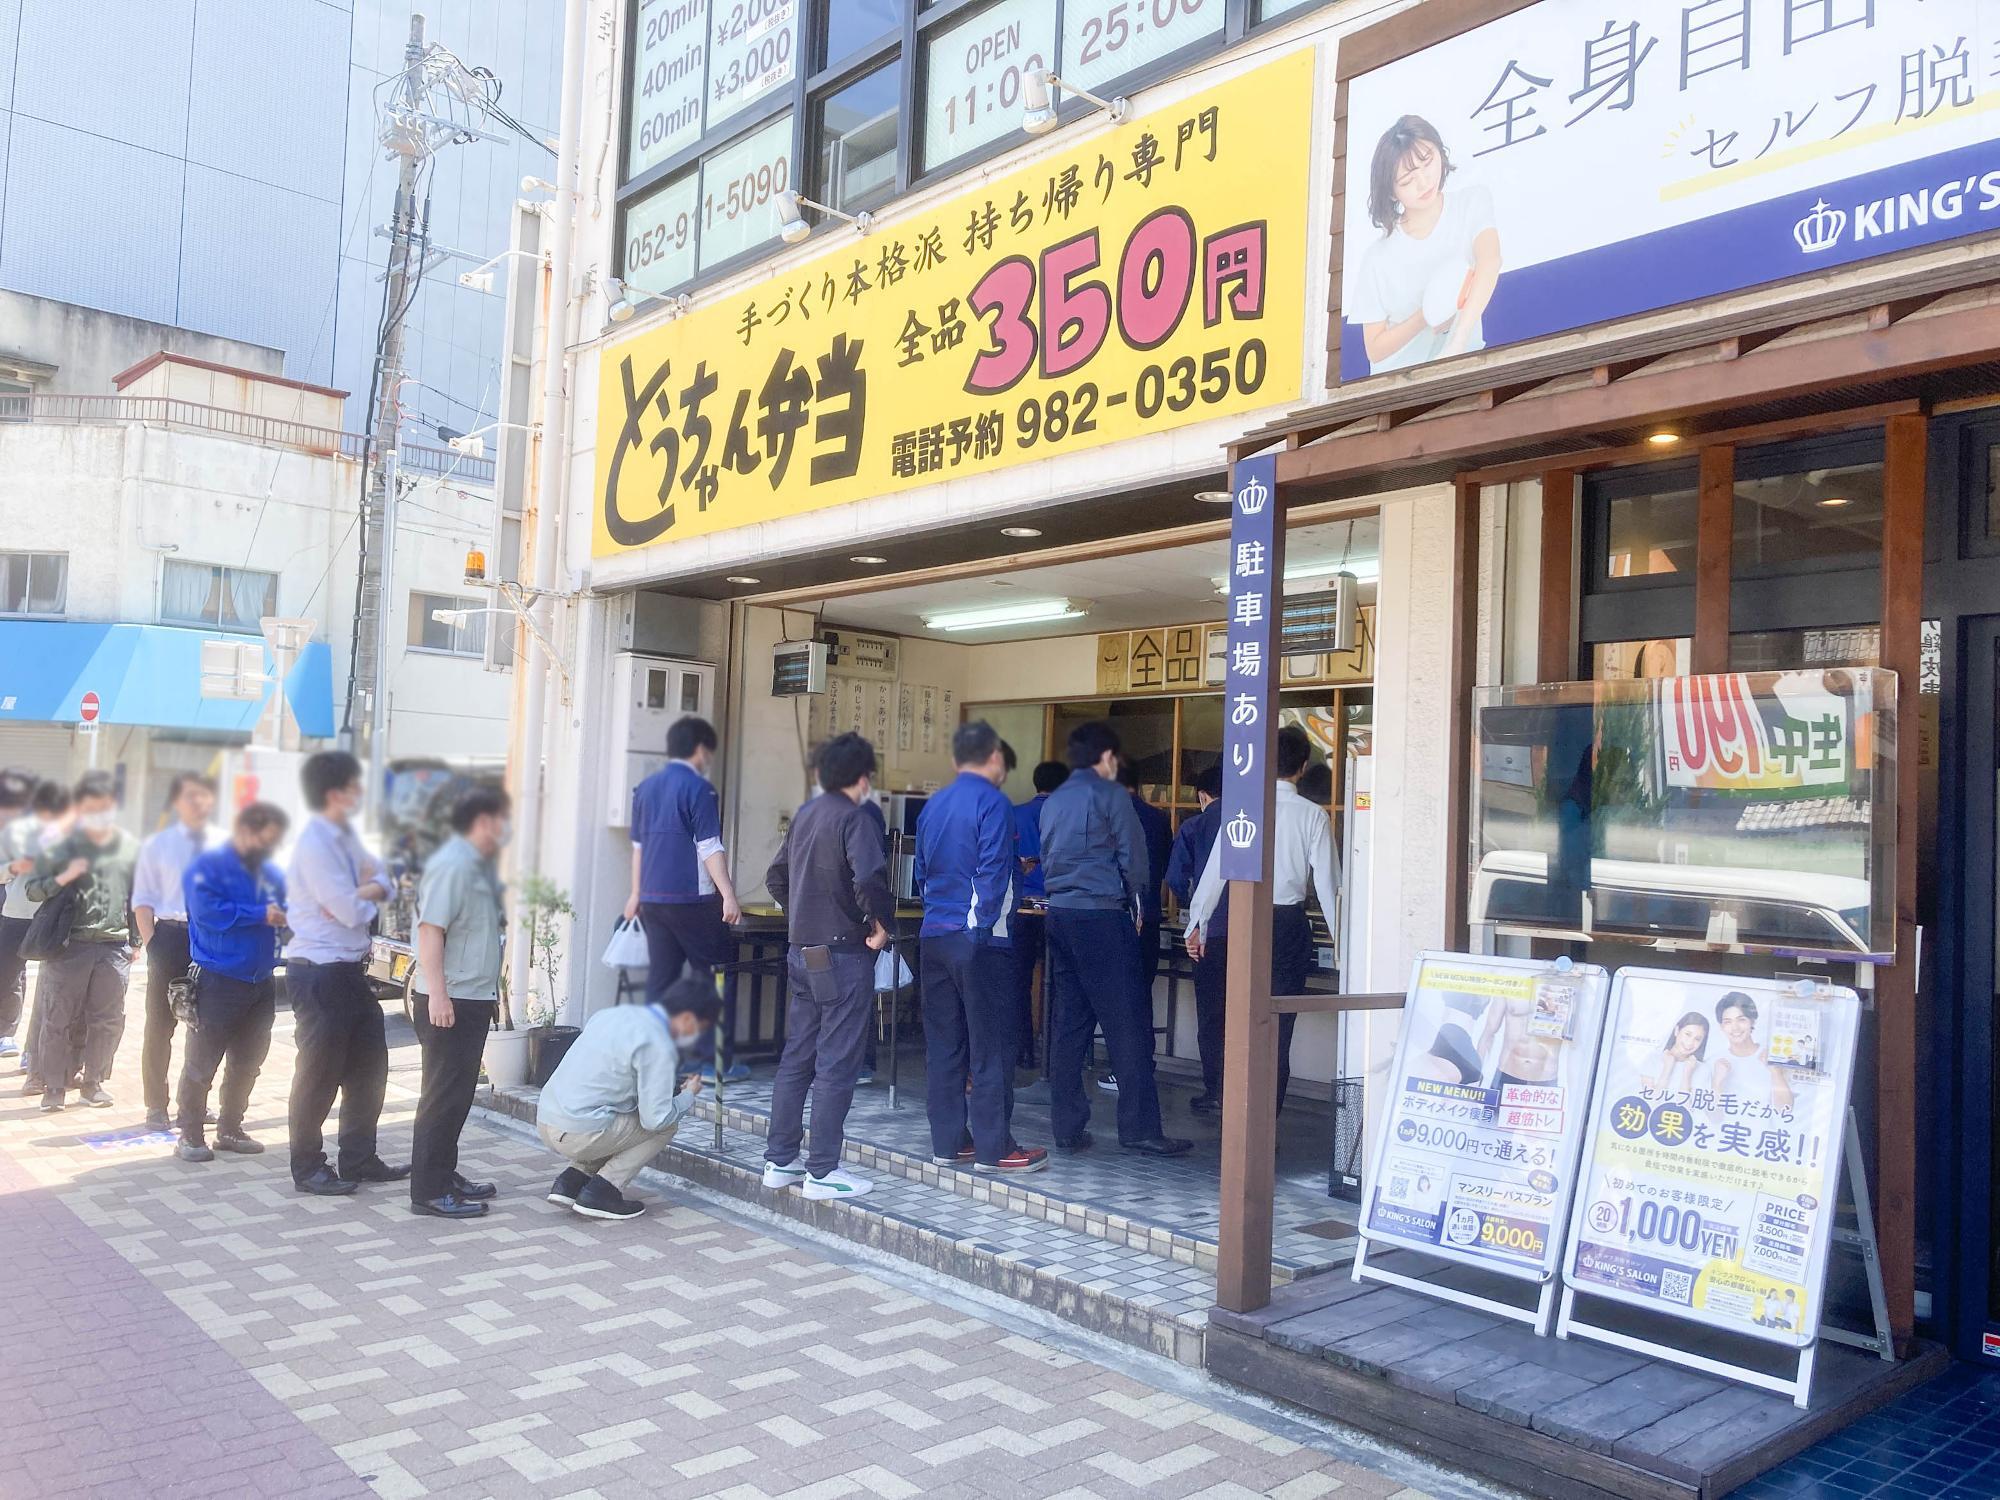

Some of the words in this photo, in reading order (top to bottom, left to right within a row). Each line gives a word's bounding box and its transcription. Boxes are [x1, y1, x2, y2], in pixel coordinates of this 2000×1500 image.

[717, 0, 792, 47] ¥2,00
[715, 27, 791, 100] ¥3,000
[965, 20, 1021, 74] OPEN
[642, 44, 703, 98] 40min
[640, 97, 699, 151] 60min
[735, 230, 949, 348] 手づくり本格派
[961, 104, 1220, 256] 持ち帰り専門
[890, 409, 1004, 480] 電話予約
[1016, 337, 1267, 449] 982-0350
[1231, 541, 1267, 777] 駐車場あり
[1402, 1096, 1494, 1123] ボディメイク痩身
[1416, 1081, 1442, 1095] NEW
[1507, 1088, 1560, 1106] 革命的な
[1638, 1085, 1795, 1124] セルフ脱毛だから
[1507, 1111, 1556, 1128] 超筋トレ
[1411, 1216, 1437, 1230] SALON
[1619, 1196, 1702, 1251] 1,000
[1701, 1229, 1738, 1261] YEN
[1766, 1202, 1808, 1222] PRICE
[1481, 1222, 1544, 1254] 9,000円
[1594, 1259, 1626, 1278] KING'S
[1626, 1267, 1659, 1284] SALON
